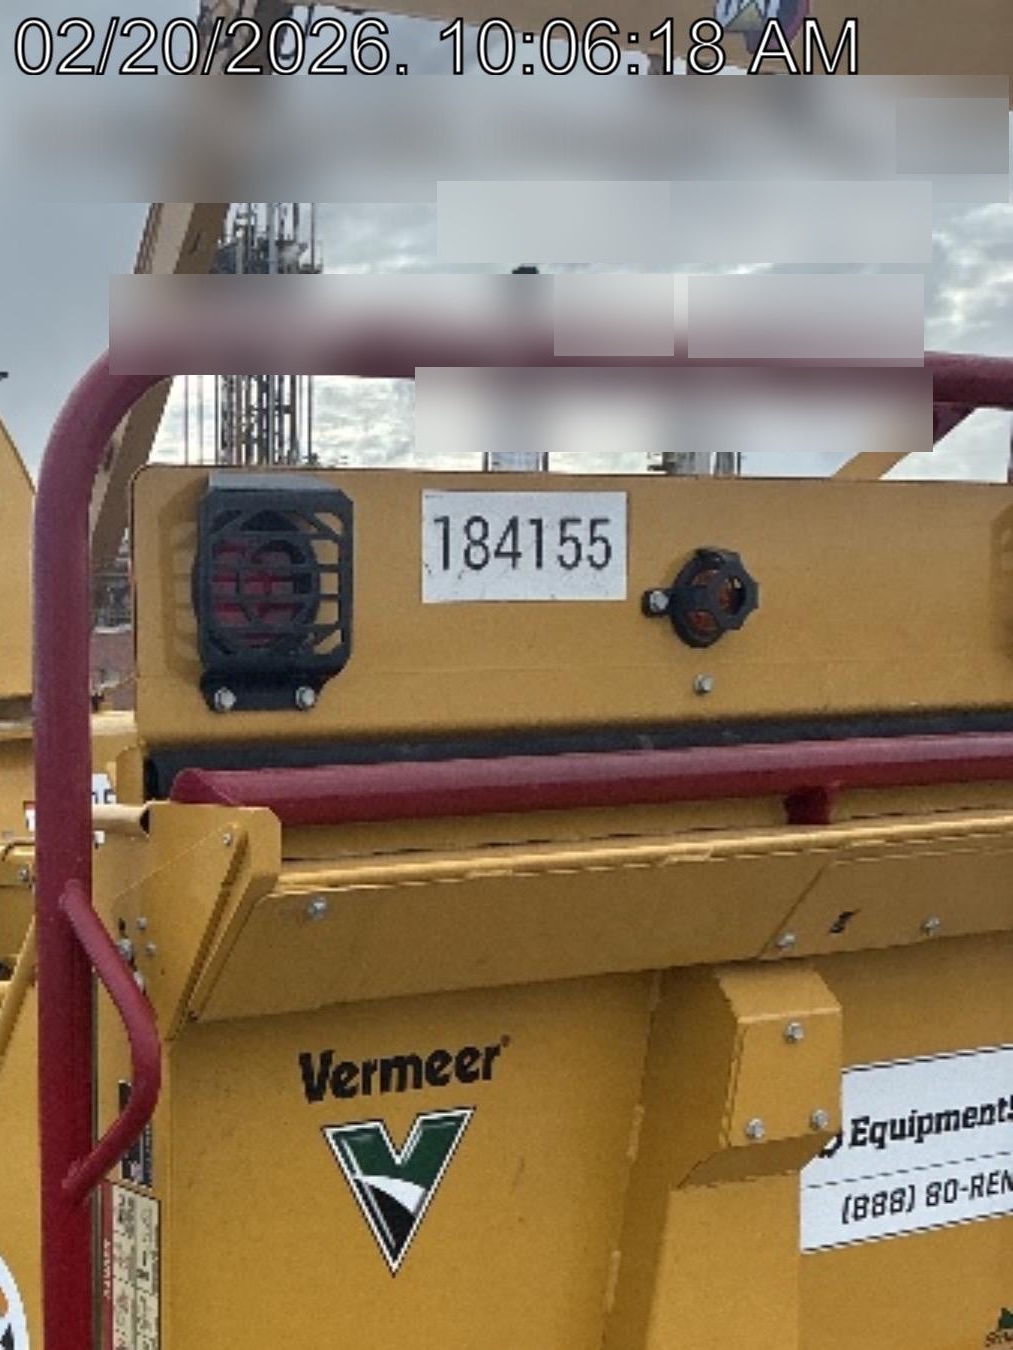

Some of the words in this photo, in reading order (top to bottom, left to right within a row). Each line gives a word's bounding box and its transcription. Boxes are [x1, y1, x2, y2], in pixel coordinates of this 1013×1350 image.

[433, 515, 612, 571] 184155
[299, 1044, 501, 1104] Vermeer
[842, 1185, 916, 1224] (888)
